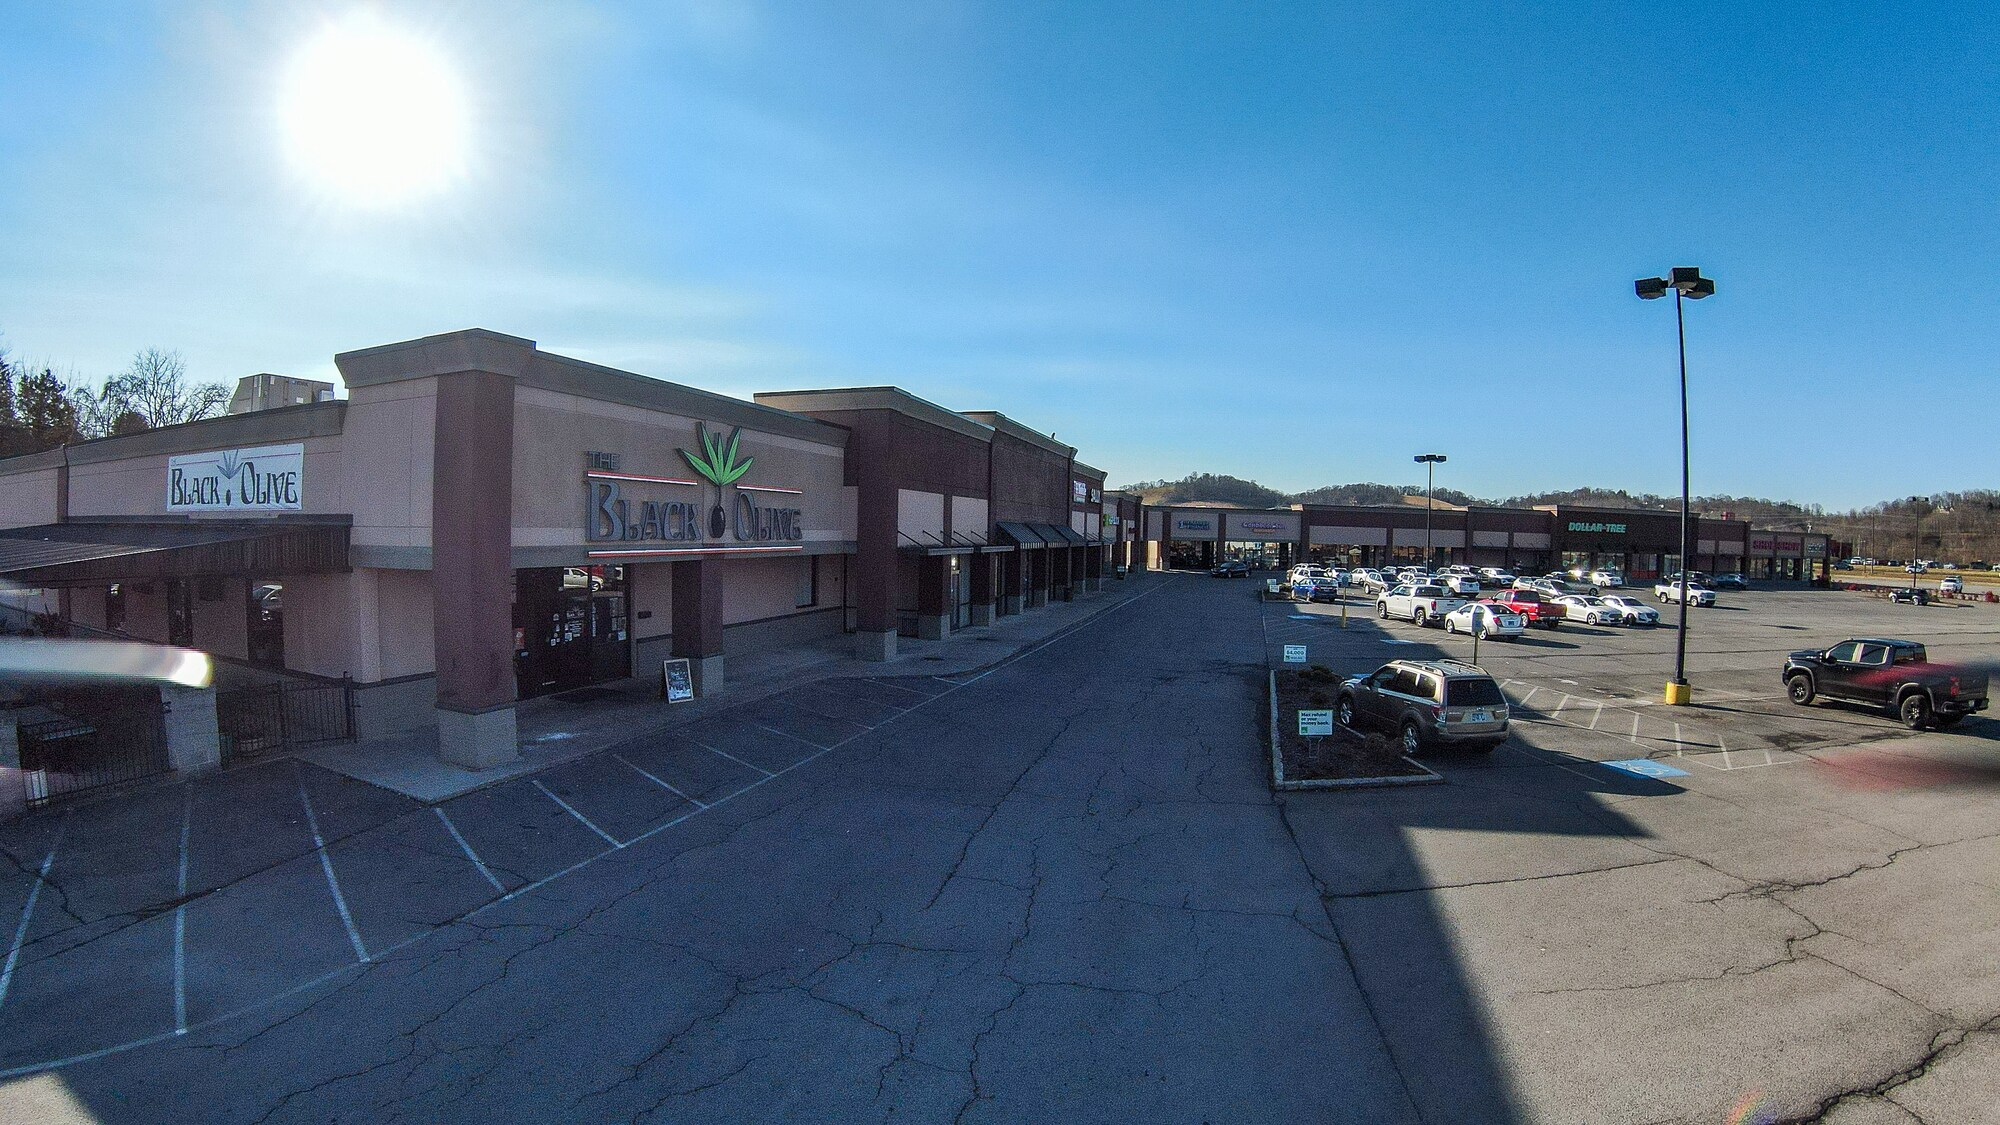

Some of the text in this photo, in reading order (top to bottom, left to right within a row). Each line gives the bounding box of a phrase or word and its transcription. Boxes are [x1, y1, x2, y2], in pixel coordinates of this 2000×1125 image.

[588, 451, 620, 470] THE
[171, 461, 298, 505] BLACK OLIVE
[585, 480, 802, 541] BLACK OLIVE
[1568, 522, 1627, 533] DOLLAR TREE
